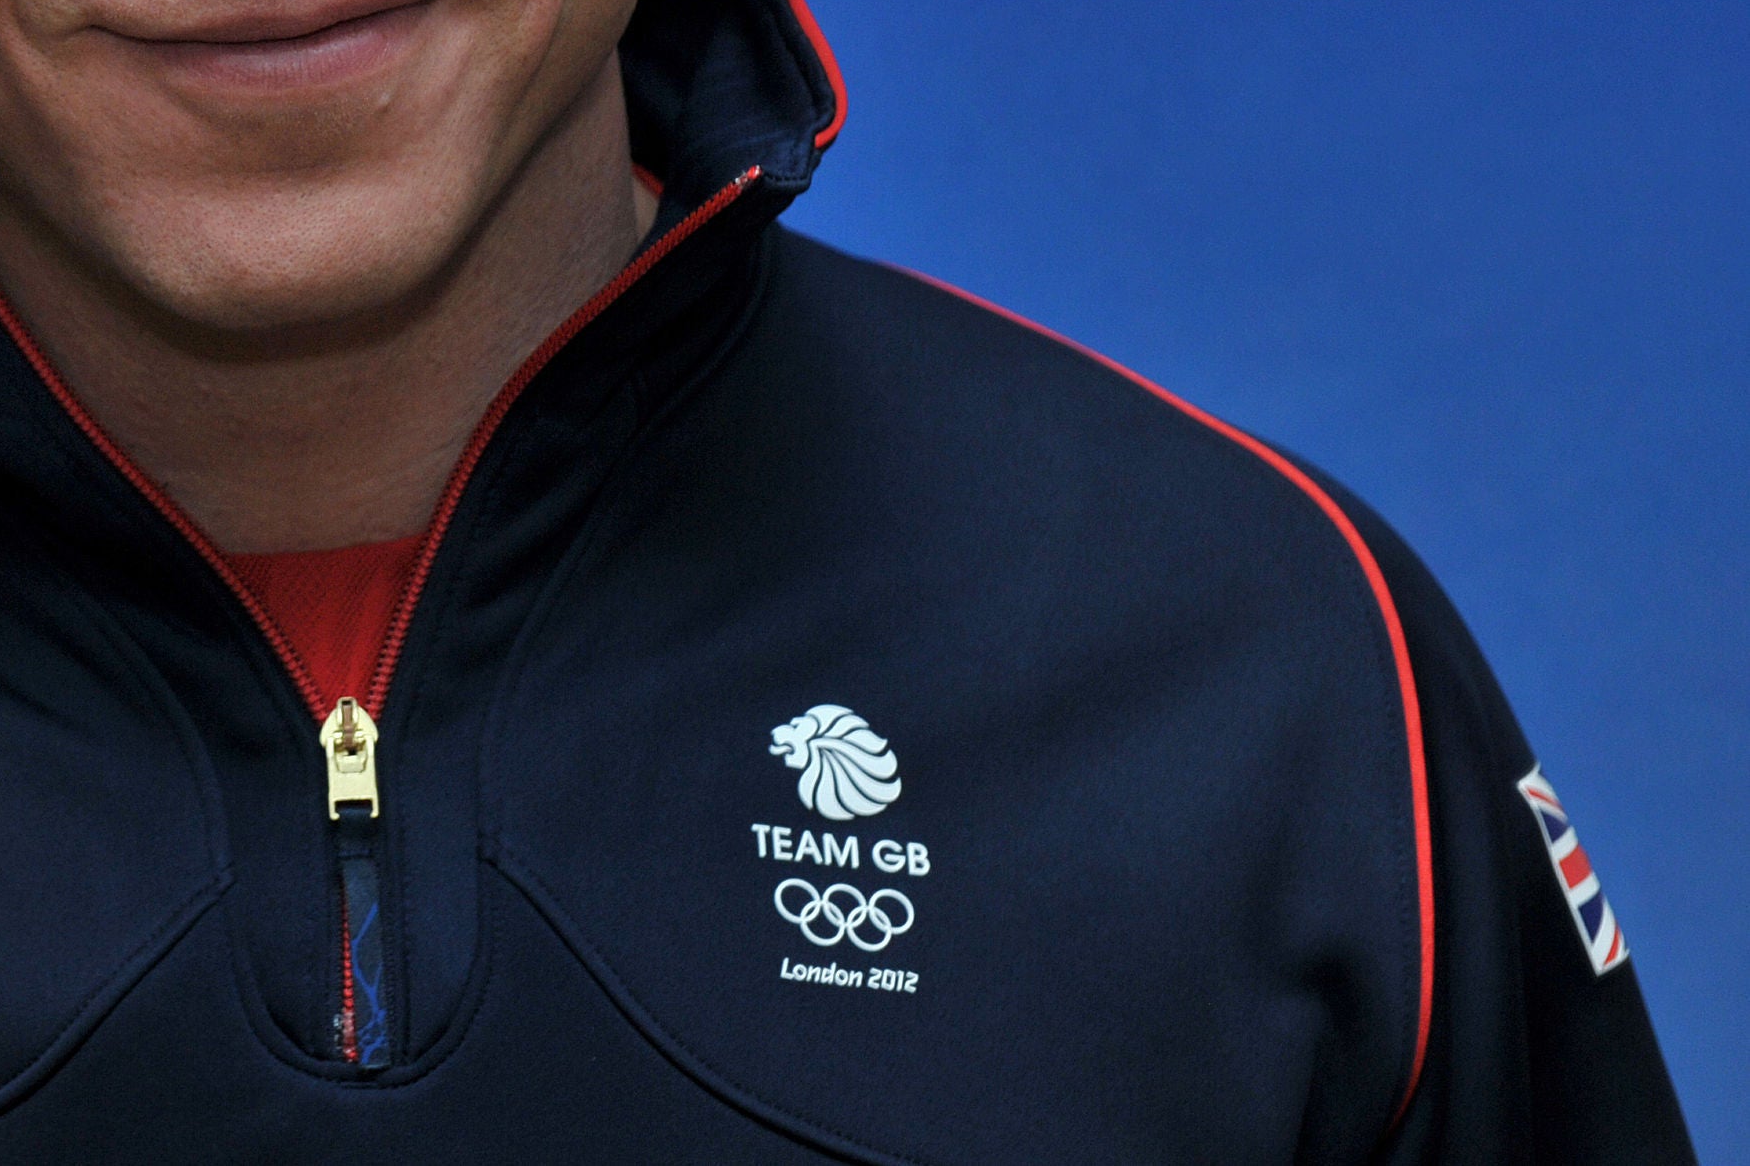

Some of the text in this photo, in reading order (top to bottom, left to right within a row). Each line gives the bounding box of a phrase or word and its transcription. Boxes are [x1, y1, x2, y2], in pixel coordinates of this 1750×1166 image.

[751, 823, 931, 876] TEAM GB
[779, 957, 920, 994] London 2012
